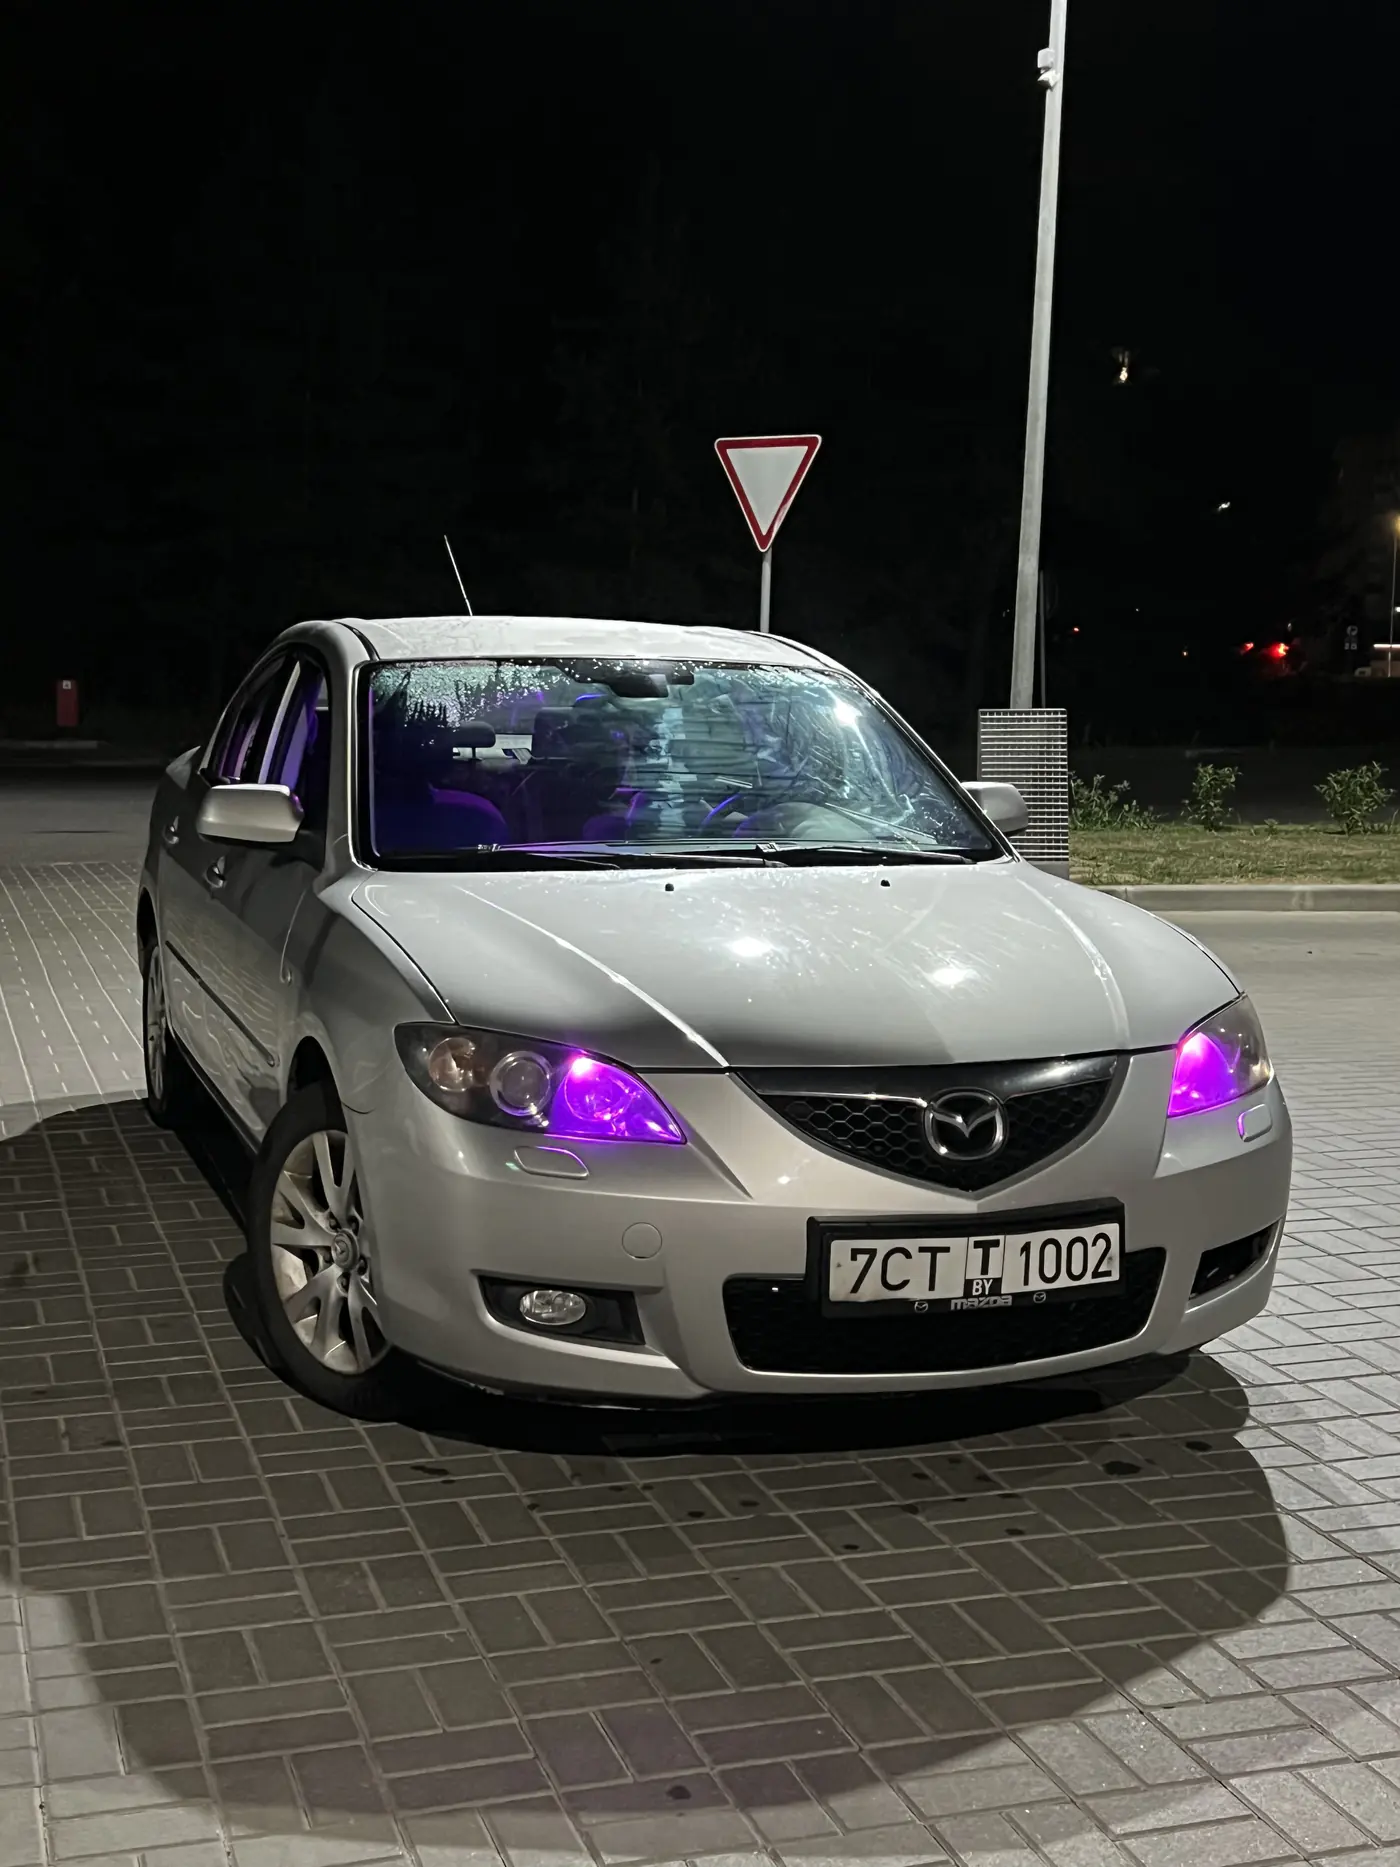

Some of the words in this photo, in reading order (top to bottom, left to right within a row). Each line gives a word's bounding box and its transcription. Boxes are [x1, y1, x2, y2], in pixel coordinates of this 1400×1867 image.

[850, 1247, 951, 1294] 7CT
[973, 1239, 1001, 1276] T
[1019, 1232, 1112, 1286] 1002
[972, 1279, 993, 1296] BY
